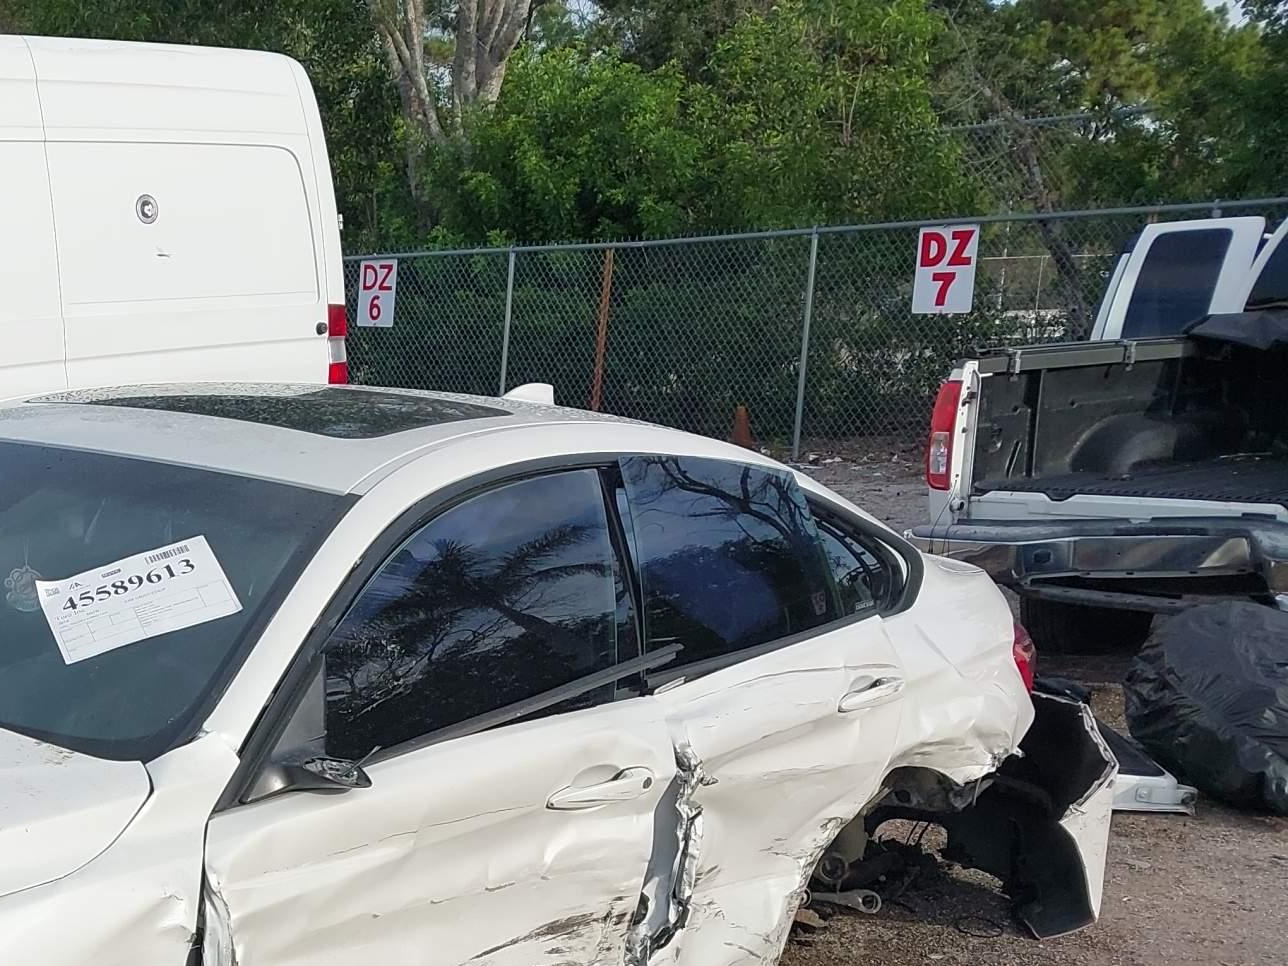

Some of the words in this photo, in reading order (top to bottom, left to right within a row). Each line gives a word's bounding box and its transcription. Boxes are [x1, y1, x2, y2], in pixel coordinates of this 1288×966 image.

[920, 229, 976, 267] DZ
[362, 264, 394, 291] DZ
[931, 271, 957, 306] 7
[369, 294, 381, 321] 6
[62, 558, 196, 612] 45589613
